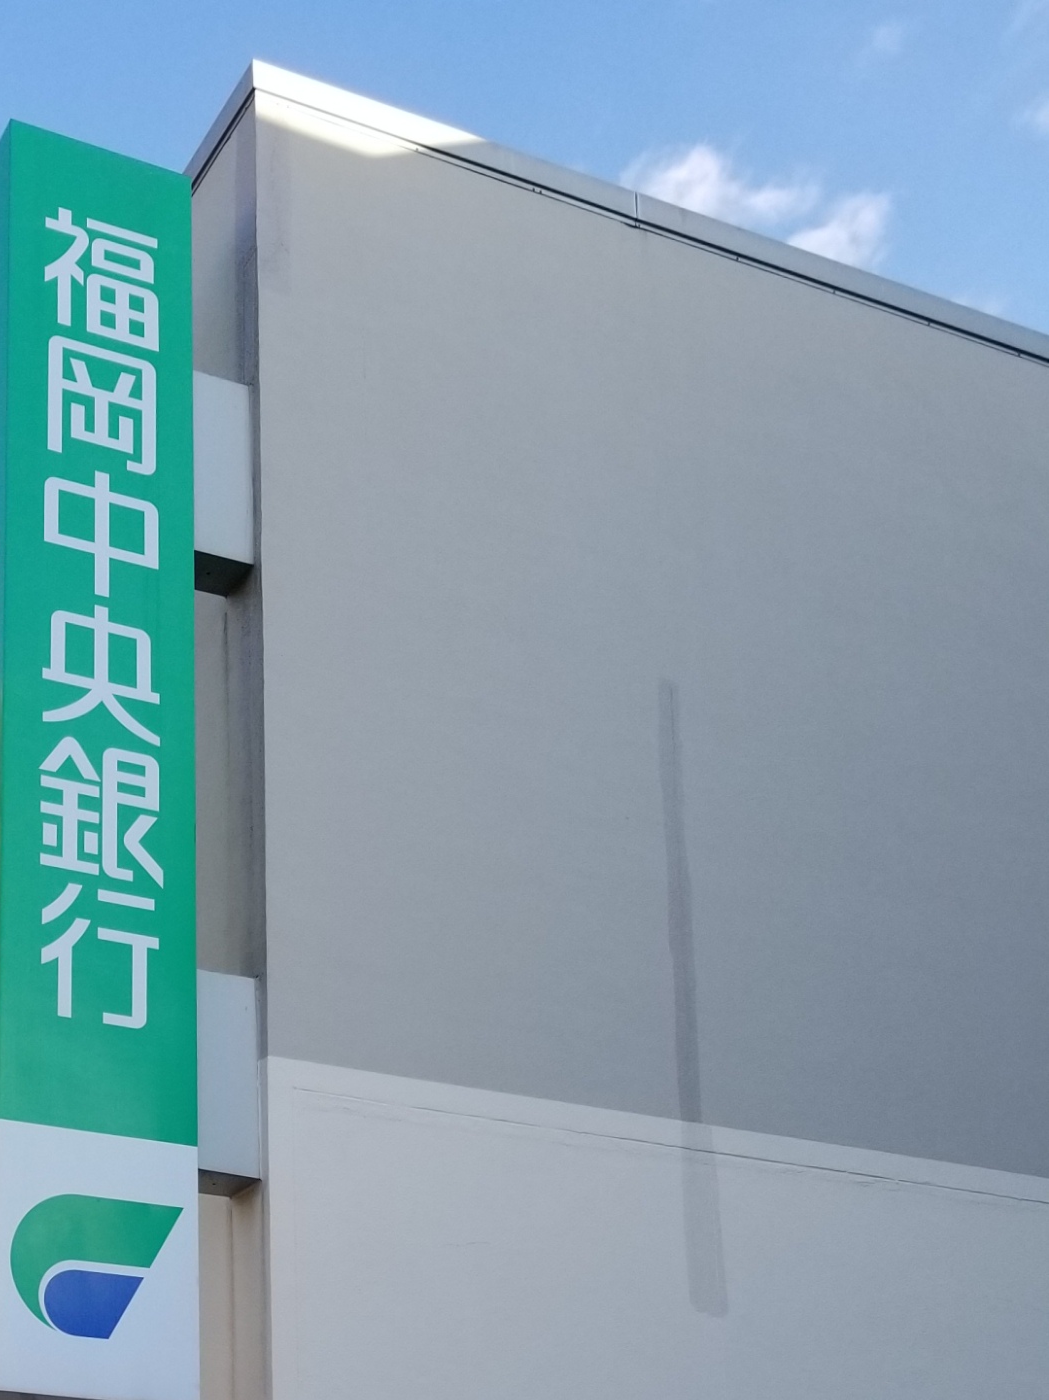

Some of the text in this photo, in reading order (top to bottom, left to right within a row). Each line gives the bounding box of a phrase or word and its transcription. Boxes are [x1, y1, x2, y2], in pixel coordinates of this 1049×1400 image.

[39, 206, 164, 1029] 福岡中央銀行
